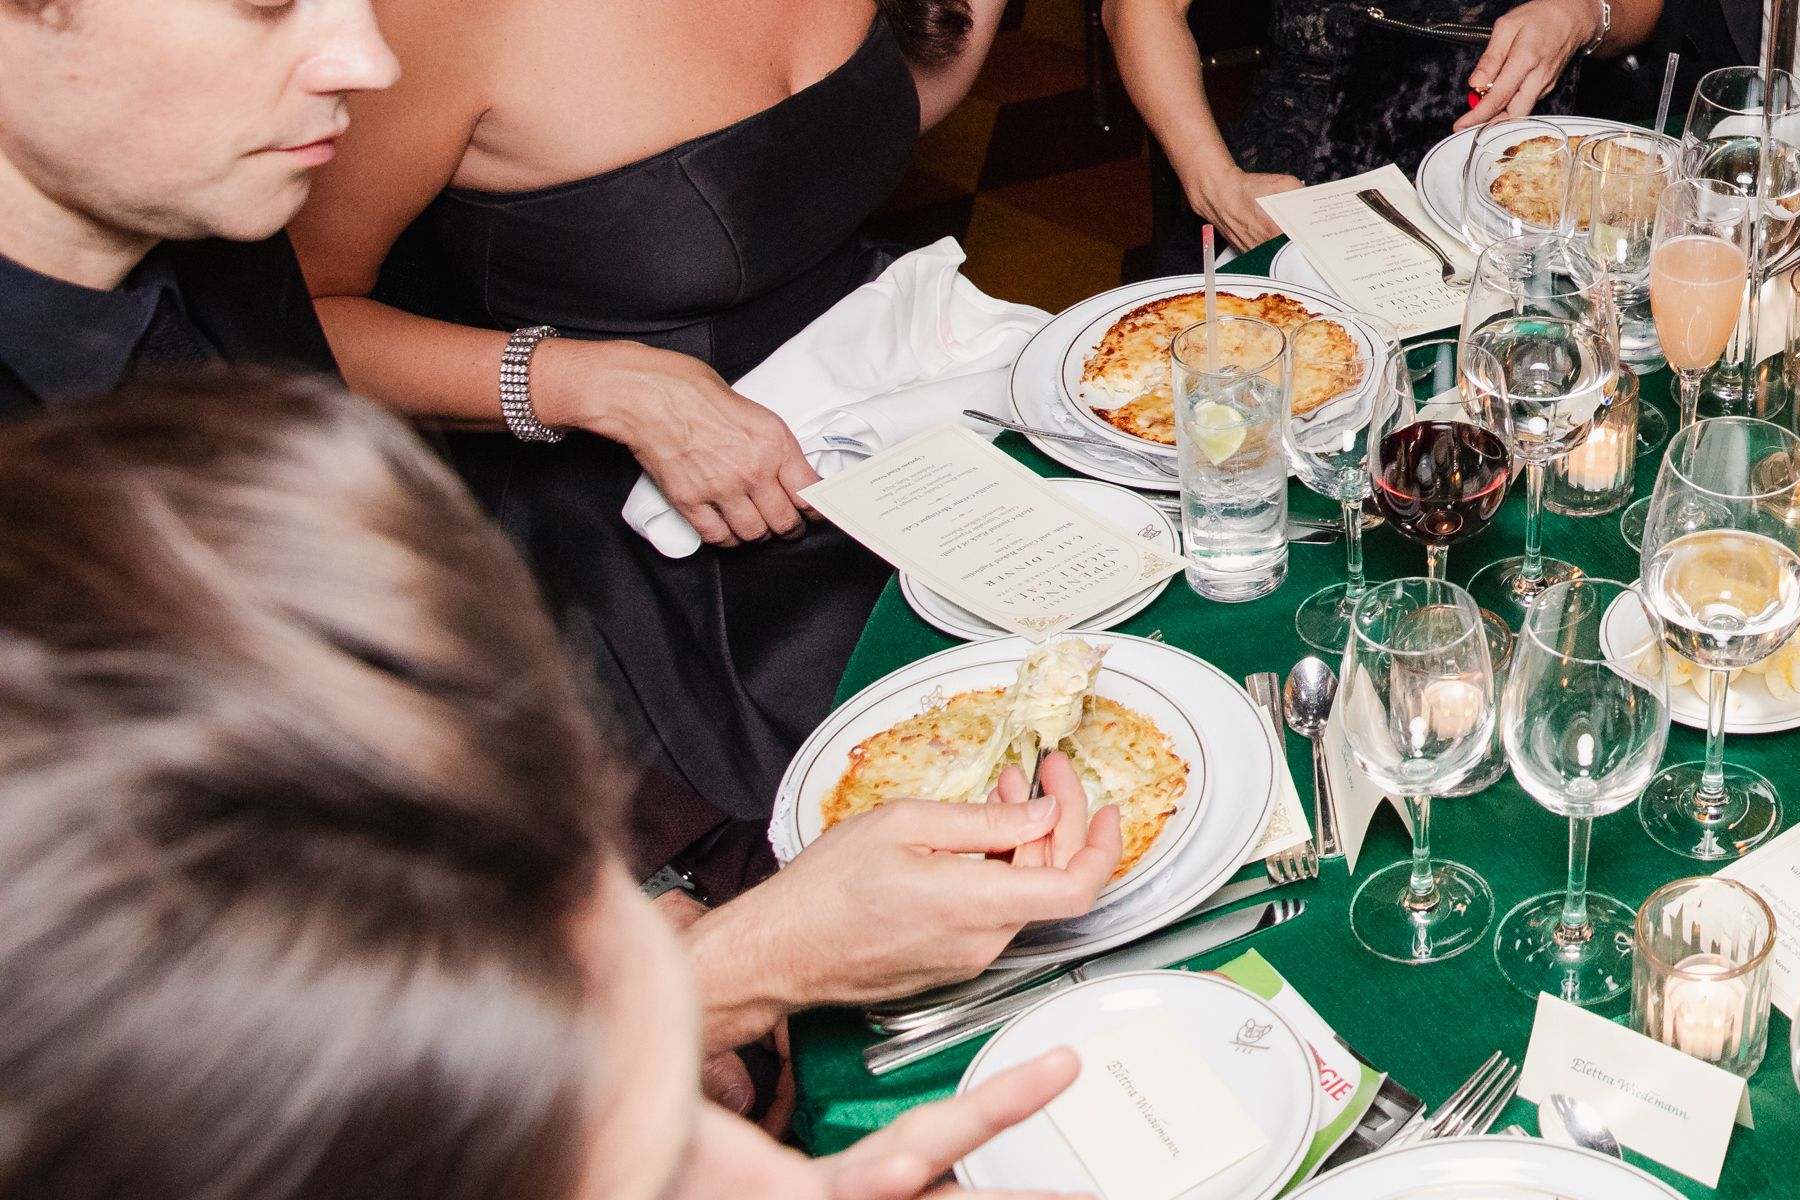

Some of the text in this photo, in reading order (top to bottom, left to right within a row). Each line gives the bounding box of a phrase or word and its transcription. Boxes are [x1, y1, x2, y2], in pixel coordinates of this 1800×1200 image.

[981, 533, 1086, 587] GALA DINNER
[1001, 544, 1120, 607] NIGHT GALA
[1030, 558, 1118, 605] OPENING
[1039, 563, 1130, 611] CARNEGIE HALL
[1569, 1056, 1616, 1086] Elettra
